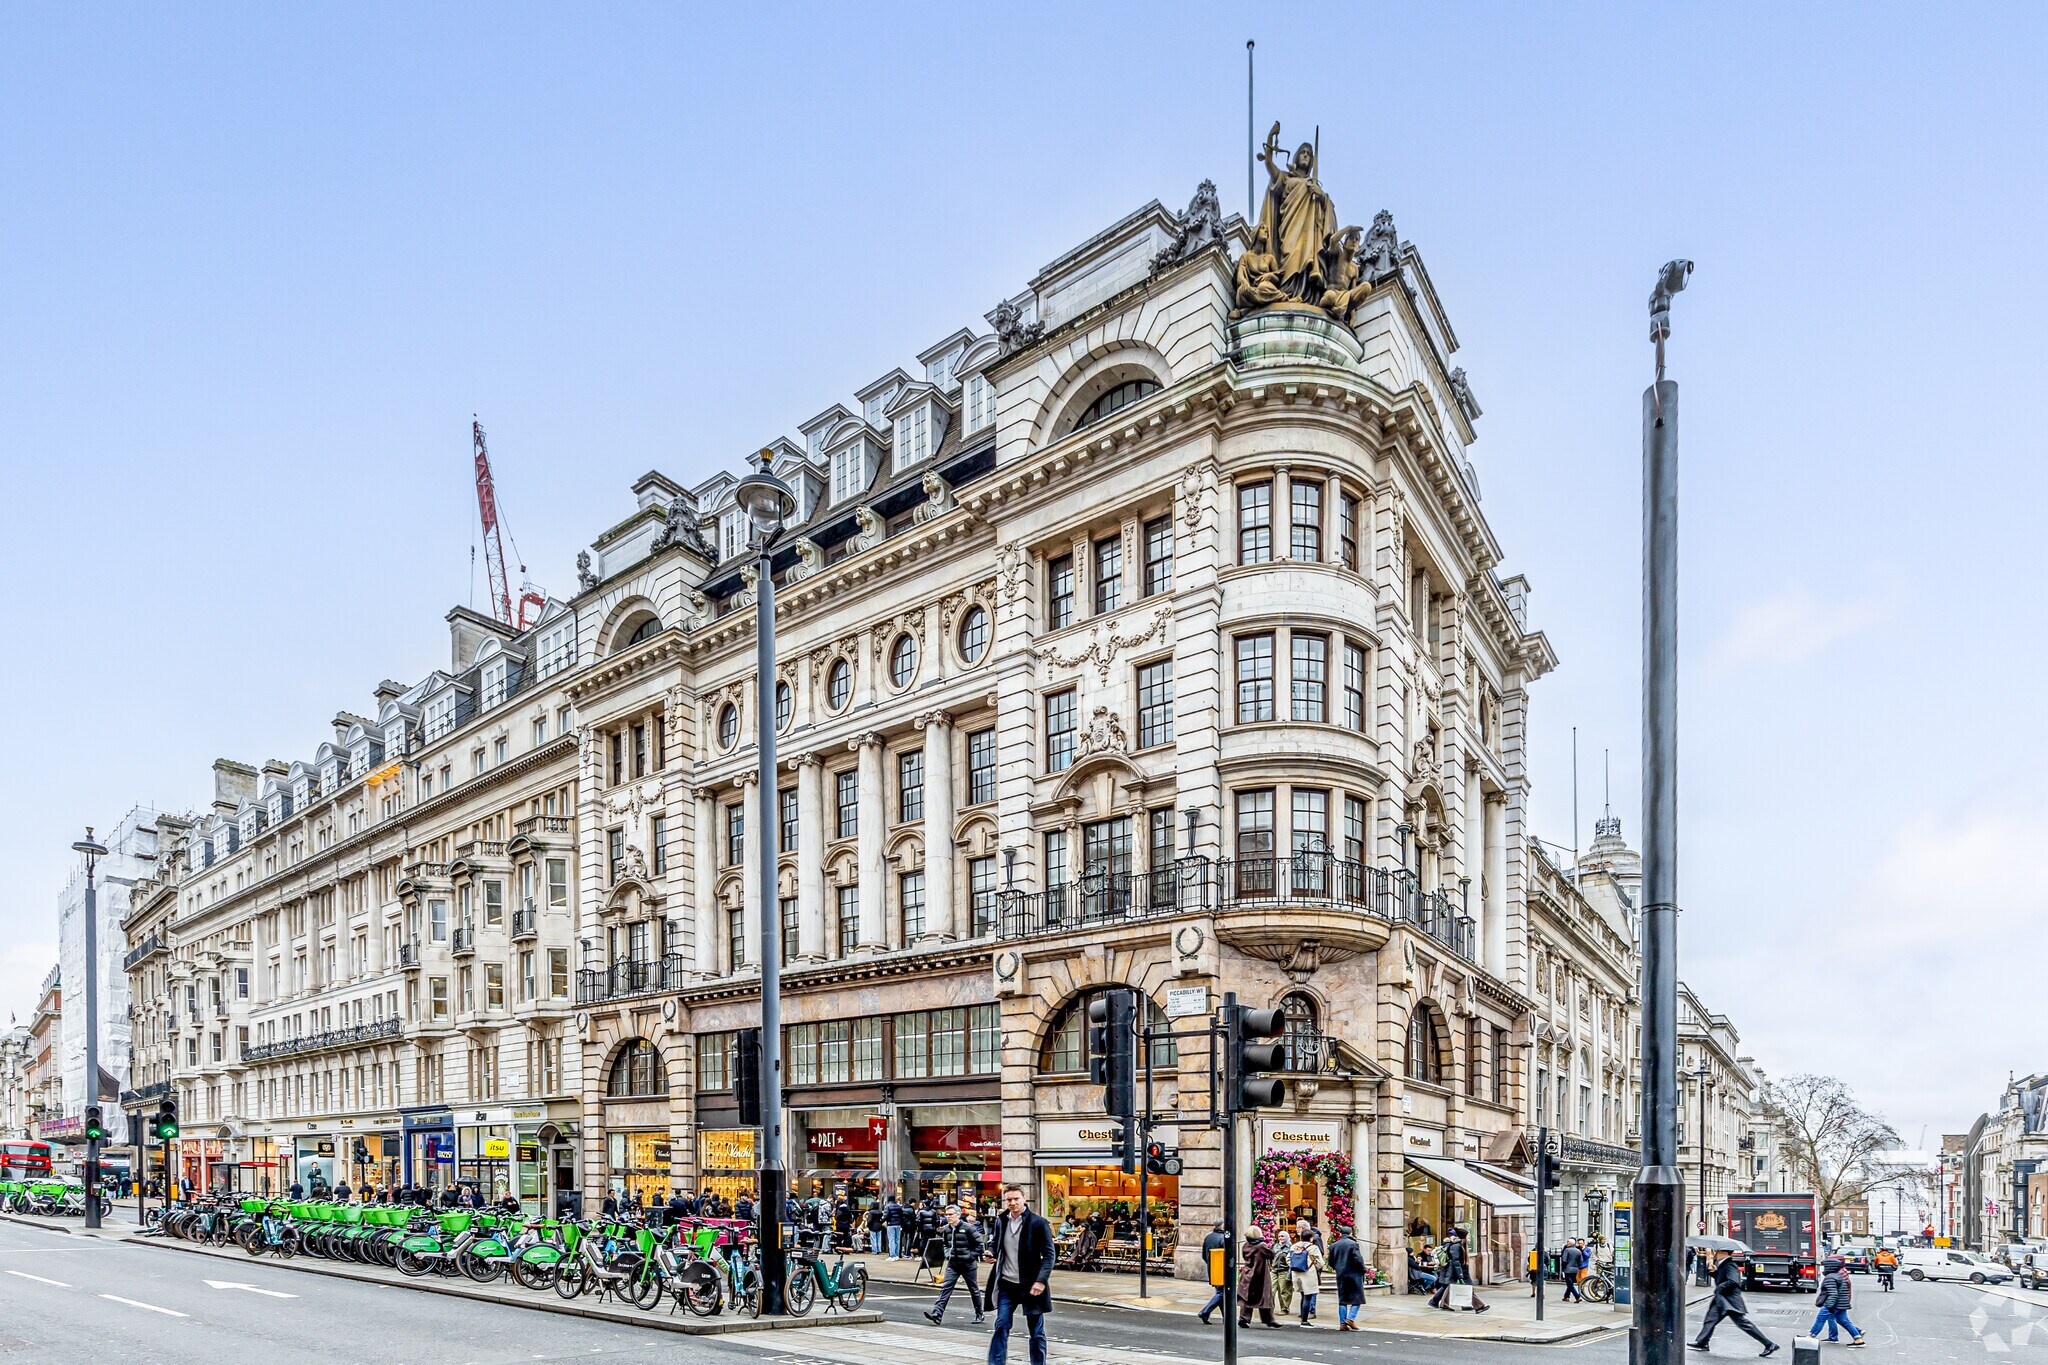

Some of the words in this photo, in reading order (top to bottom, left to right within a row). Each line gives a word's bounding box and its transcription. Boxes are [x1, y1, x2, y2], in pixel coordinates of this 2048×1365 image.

[1169, 989, 1195, 997] PICCADILLY
[1078, 1129, 1113, 1139] Chest
[1272, 1131, 1331, 1142] Chestnut
[818, 1132, 836, 1148] PRET
[490, 1143, 504, 1151] itsu
[726, 1142, 752, 1159] Venchi
